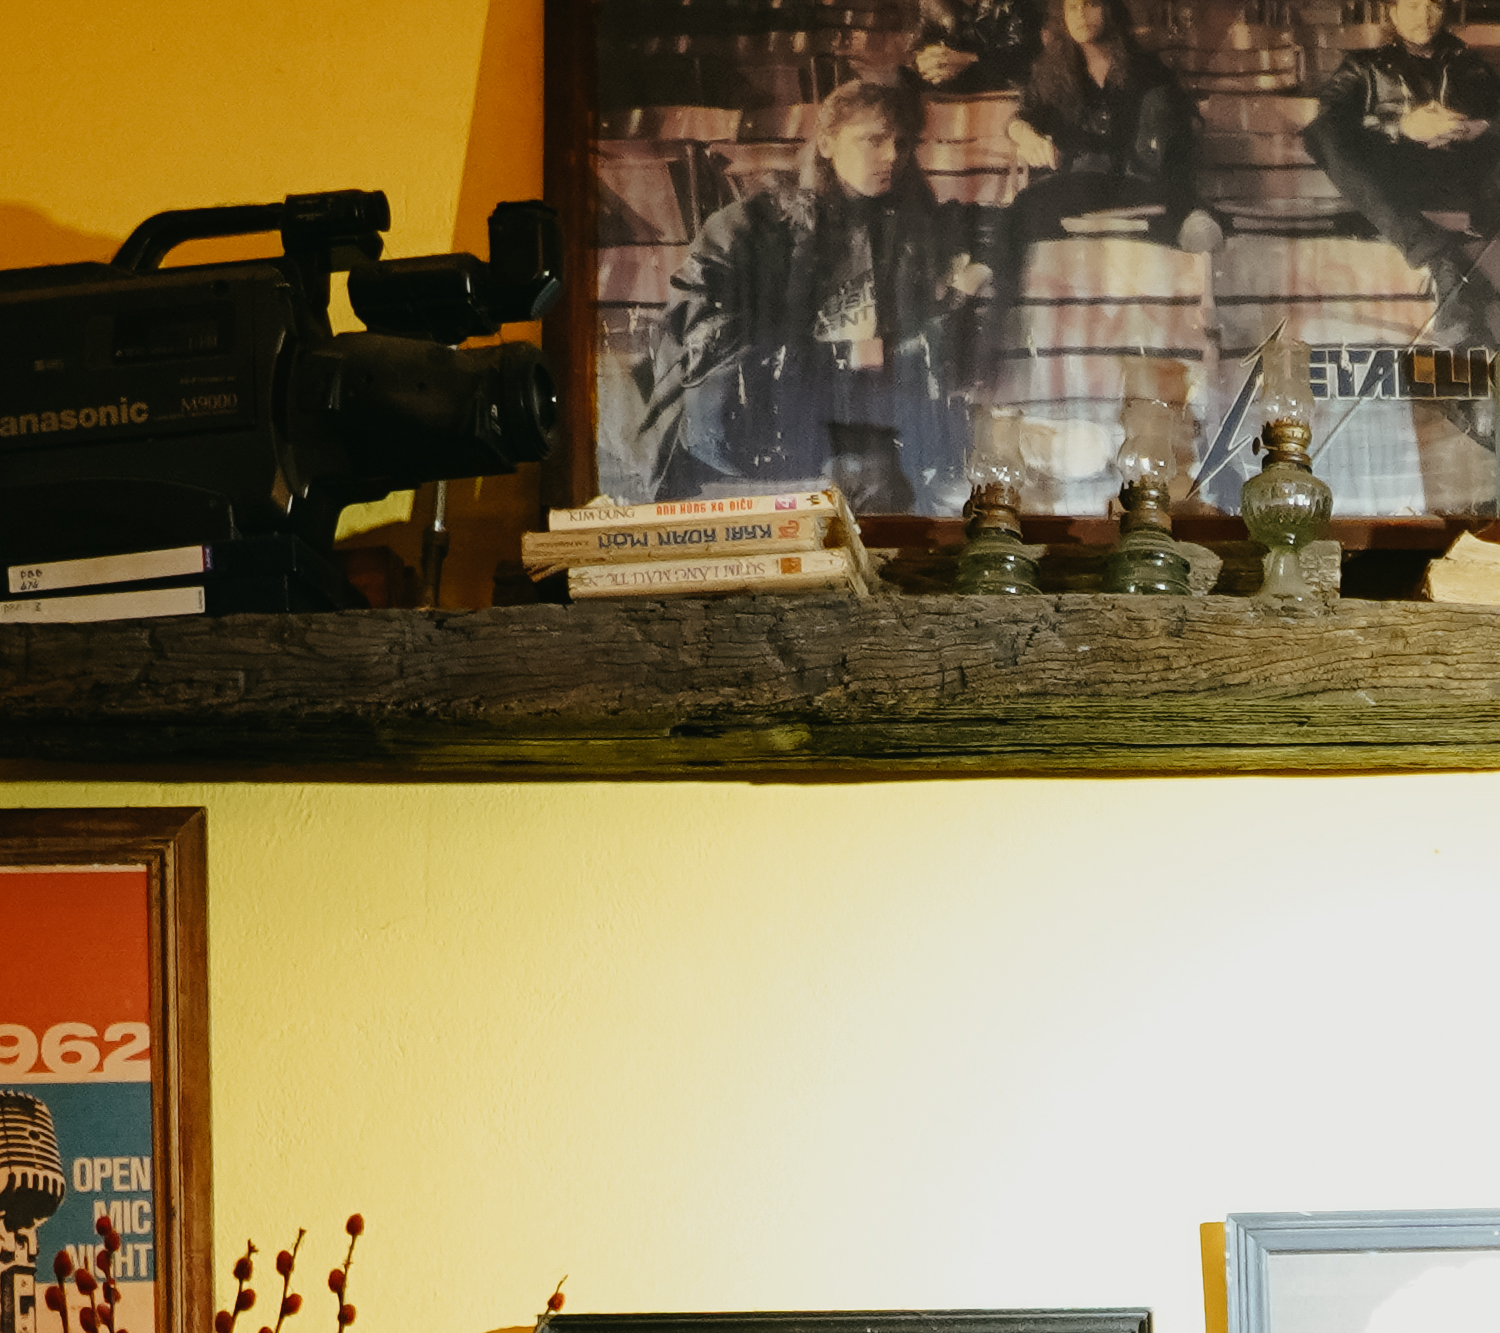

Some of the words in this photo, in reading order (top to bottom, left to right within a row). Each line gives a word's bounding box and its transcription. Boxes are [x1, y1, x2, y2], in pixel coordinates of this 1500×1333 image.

[568, 509, 596, 522] KIM
[656, 502, 677, 517] ANH
[72, 1156, 152, 1192] OPEN
[93, 1200, 152, 1235] MIC
